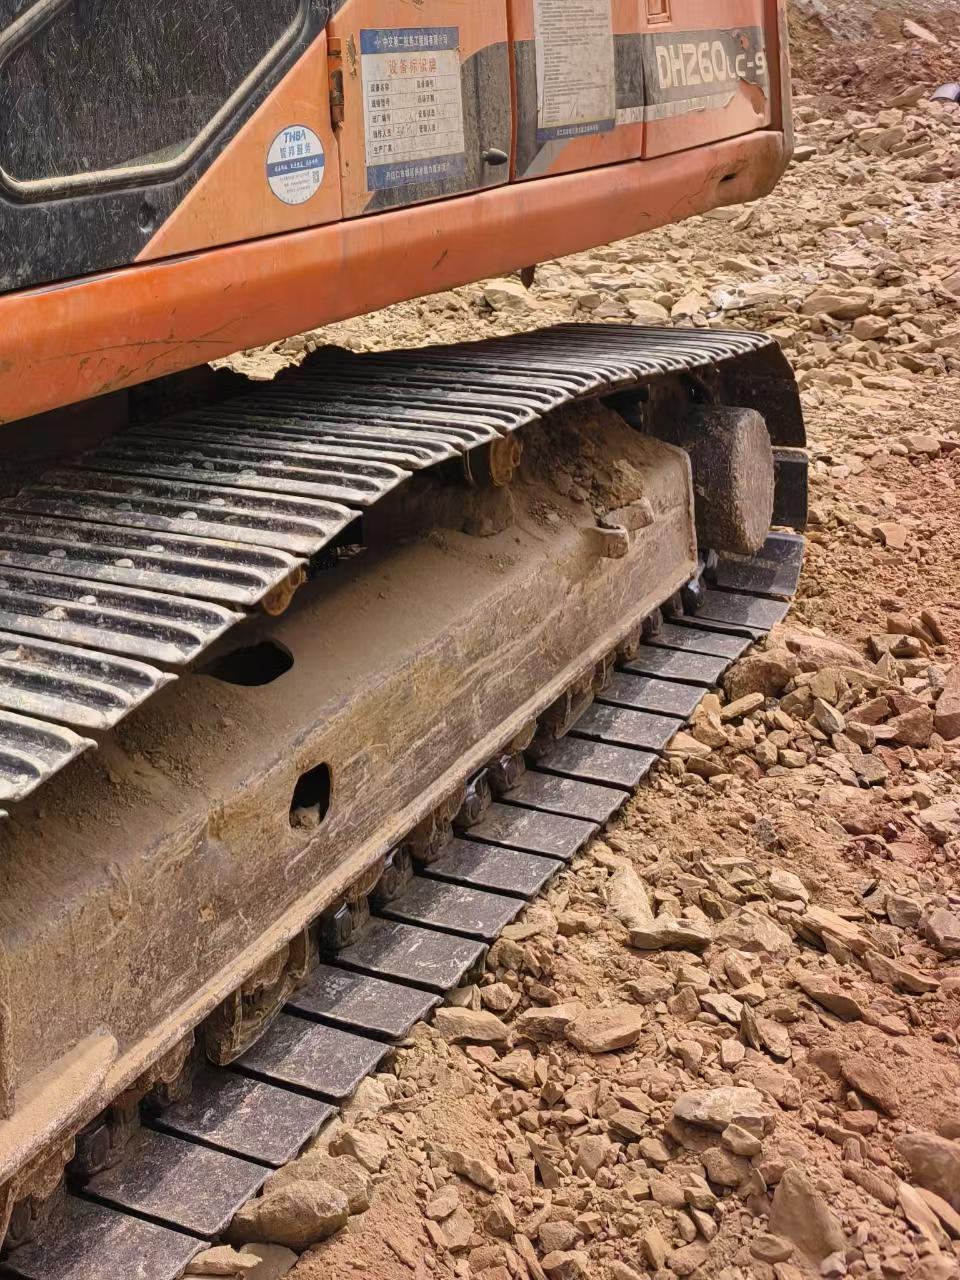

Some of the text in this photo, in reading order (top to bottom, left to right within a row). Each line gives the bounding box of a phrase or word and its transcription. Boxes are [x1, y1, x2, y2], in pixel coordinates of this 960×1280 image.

[388, 57, 437, 75] 设备标识牌
